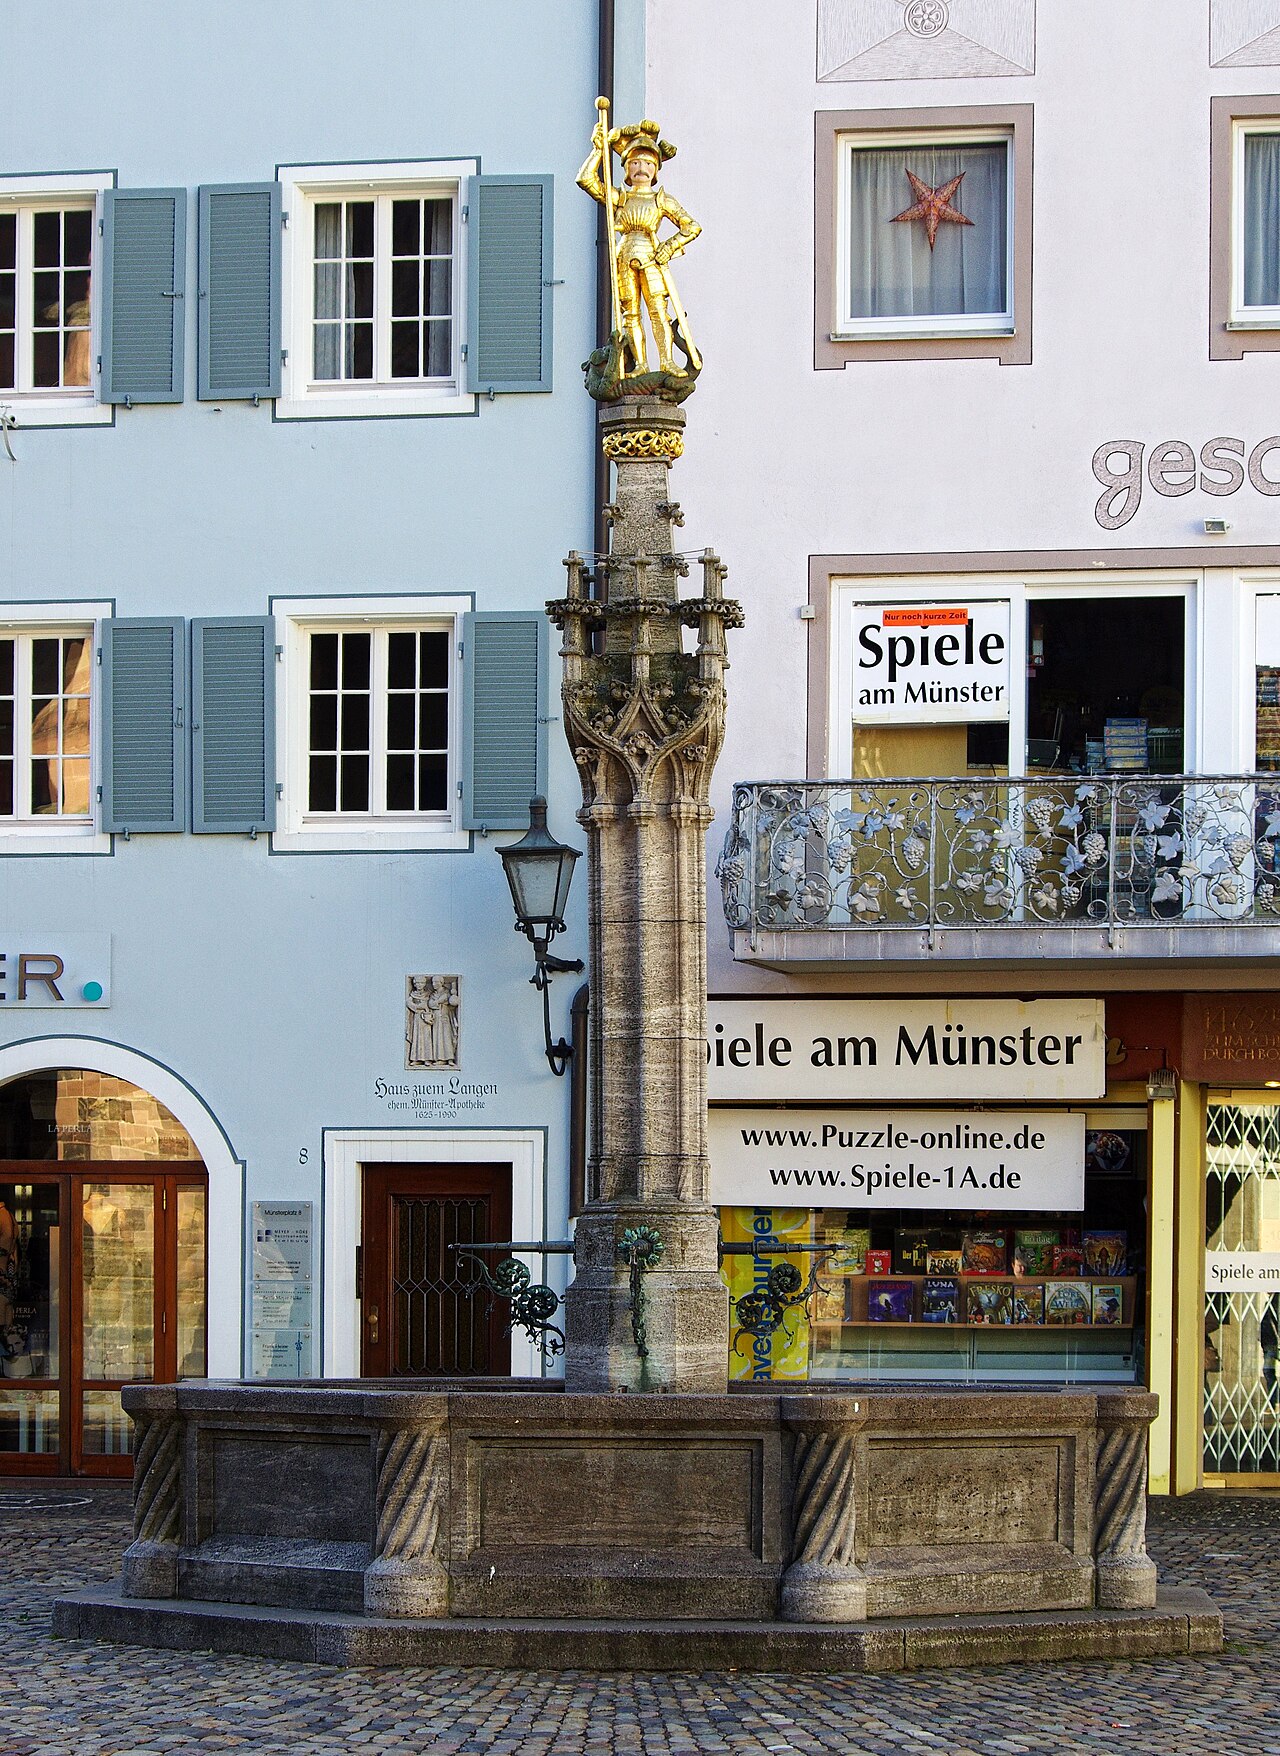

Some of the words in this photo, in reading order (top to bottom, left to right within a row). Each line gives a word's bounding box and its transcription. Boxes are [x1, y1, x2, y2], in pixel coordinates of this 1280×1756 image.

[884, 613, 900, 621] Nur
[901, 612, 922, 621] noch
[923, 612, 947, 621] kurze
[948, 611, 967, 620] Zeit
[858, 618, 1005, 682] Spiele
[859, 687, 895, 705] am
[904, 680, 1004, 704] Münster
[810, 1036, 878, 1067] am
[894, 1023, 1083, 1066] Münster
[1203, 1047, 1255, 1060] DURCH
[374, 1076, 410, 1099] Haus
[412, 1084, 445, 1098] zuem
[448, 1075, 498, 1098] Langen
[387, 1100, 410, 1111] ehem.
[414, 1110, 457, 1119] 1625-1990
[741, 1123, 1046, 1150] www.Puzzle-online.de
[298, 1147, 309, 1165] 8
[768, 1163, 1022, 1196] www.Spiele-1A.de
[1211, 1263, 1254, 1283] Spiele
[1258, 1268, 1280, 1279] am
[927, 1280, 955, 1288] LUNA
[969, 1283, 1012, 1297] FRESKO
